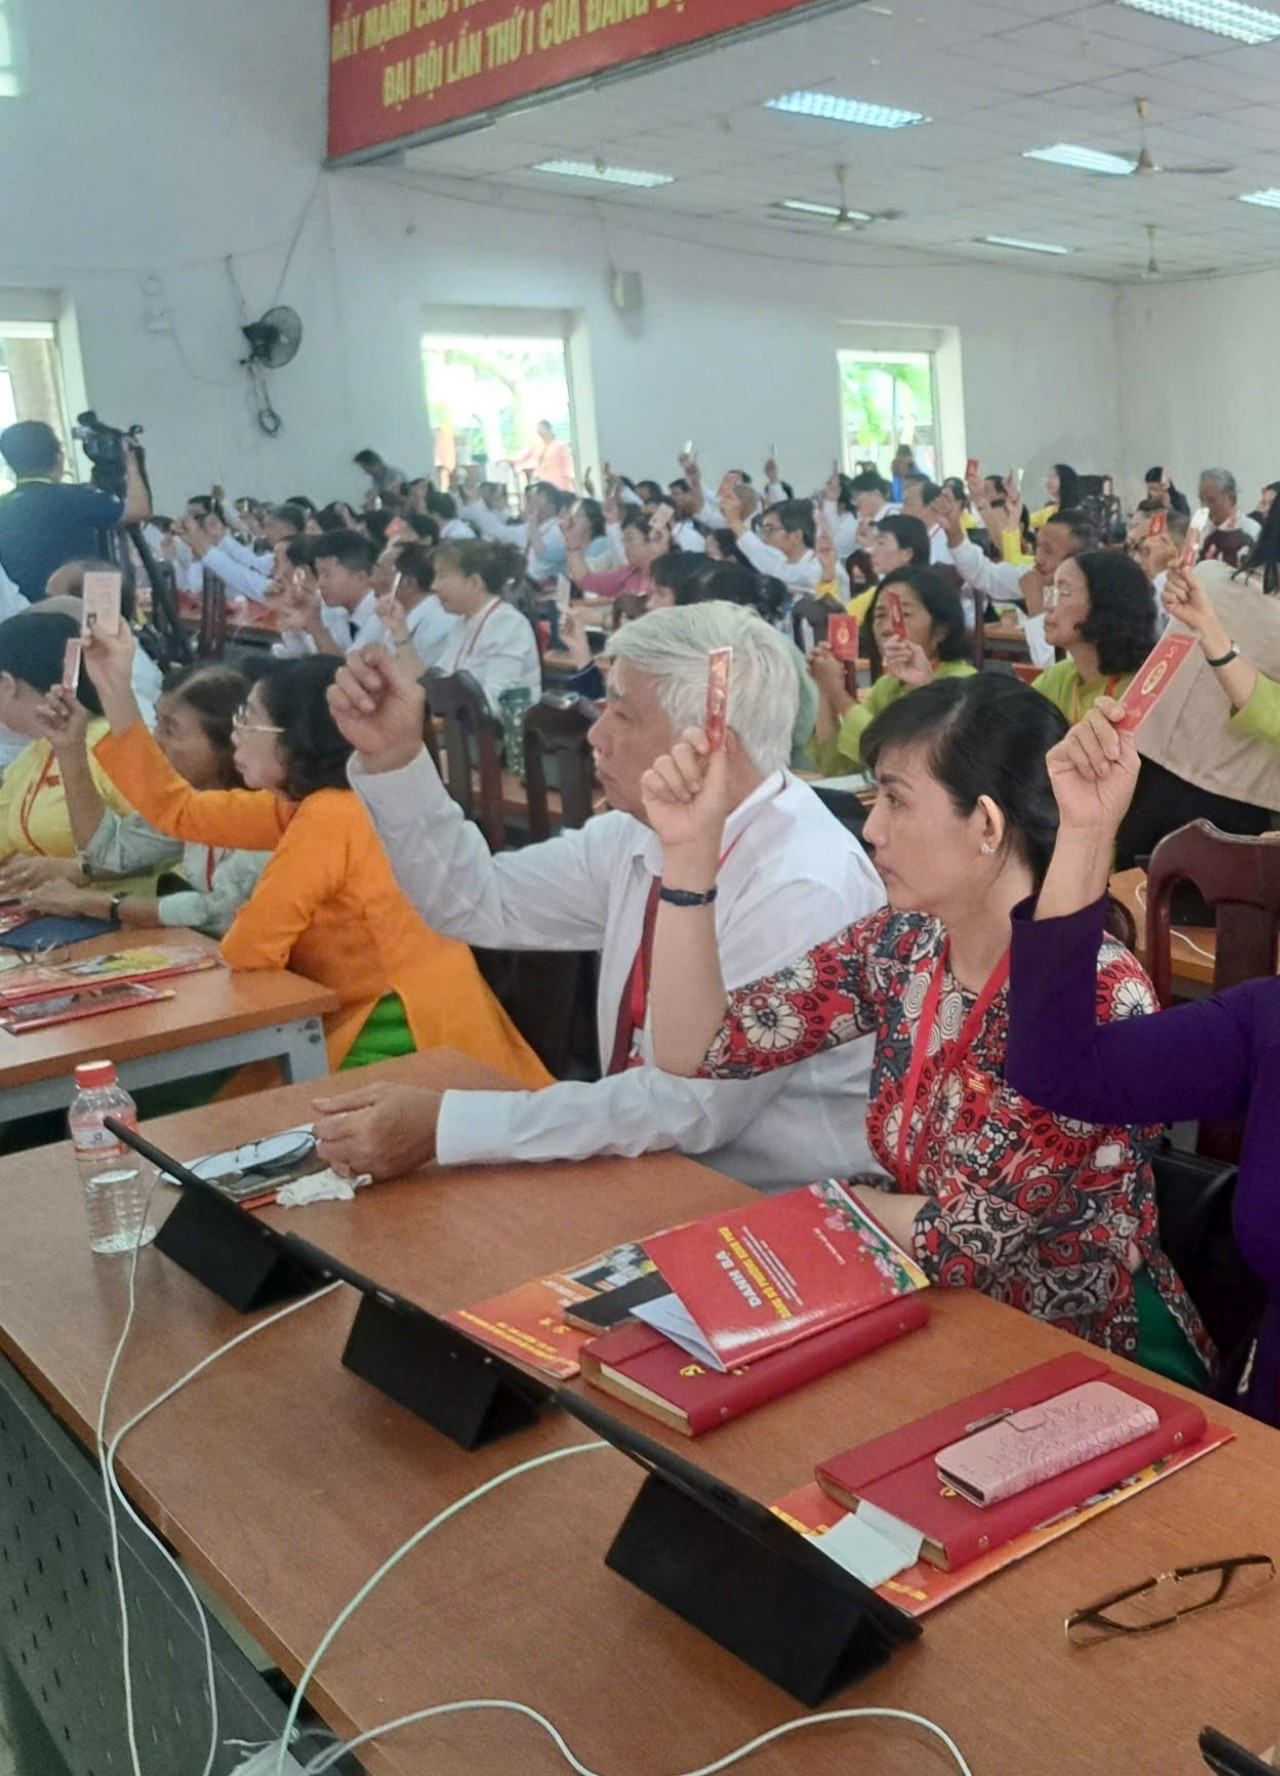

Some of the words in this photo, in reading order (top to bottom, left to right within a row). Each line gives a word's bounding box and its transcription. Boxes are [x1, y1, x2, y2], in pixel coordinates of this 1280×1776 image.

[382, 57, 411, 112] ĐẠI
[415, 40, 444, 100] HỘI
[447, 21, 482, 83] LẦN
[486, 5, 525, 69] THỨ
[715, 1250, 735, 1270] BẠ
[729, 1269, 763, 1308] DANH
